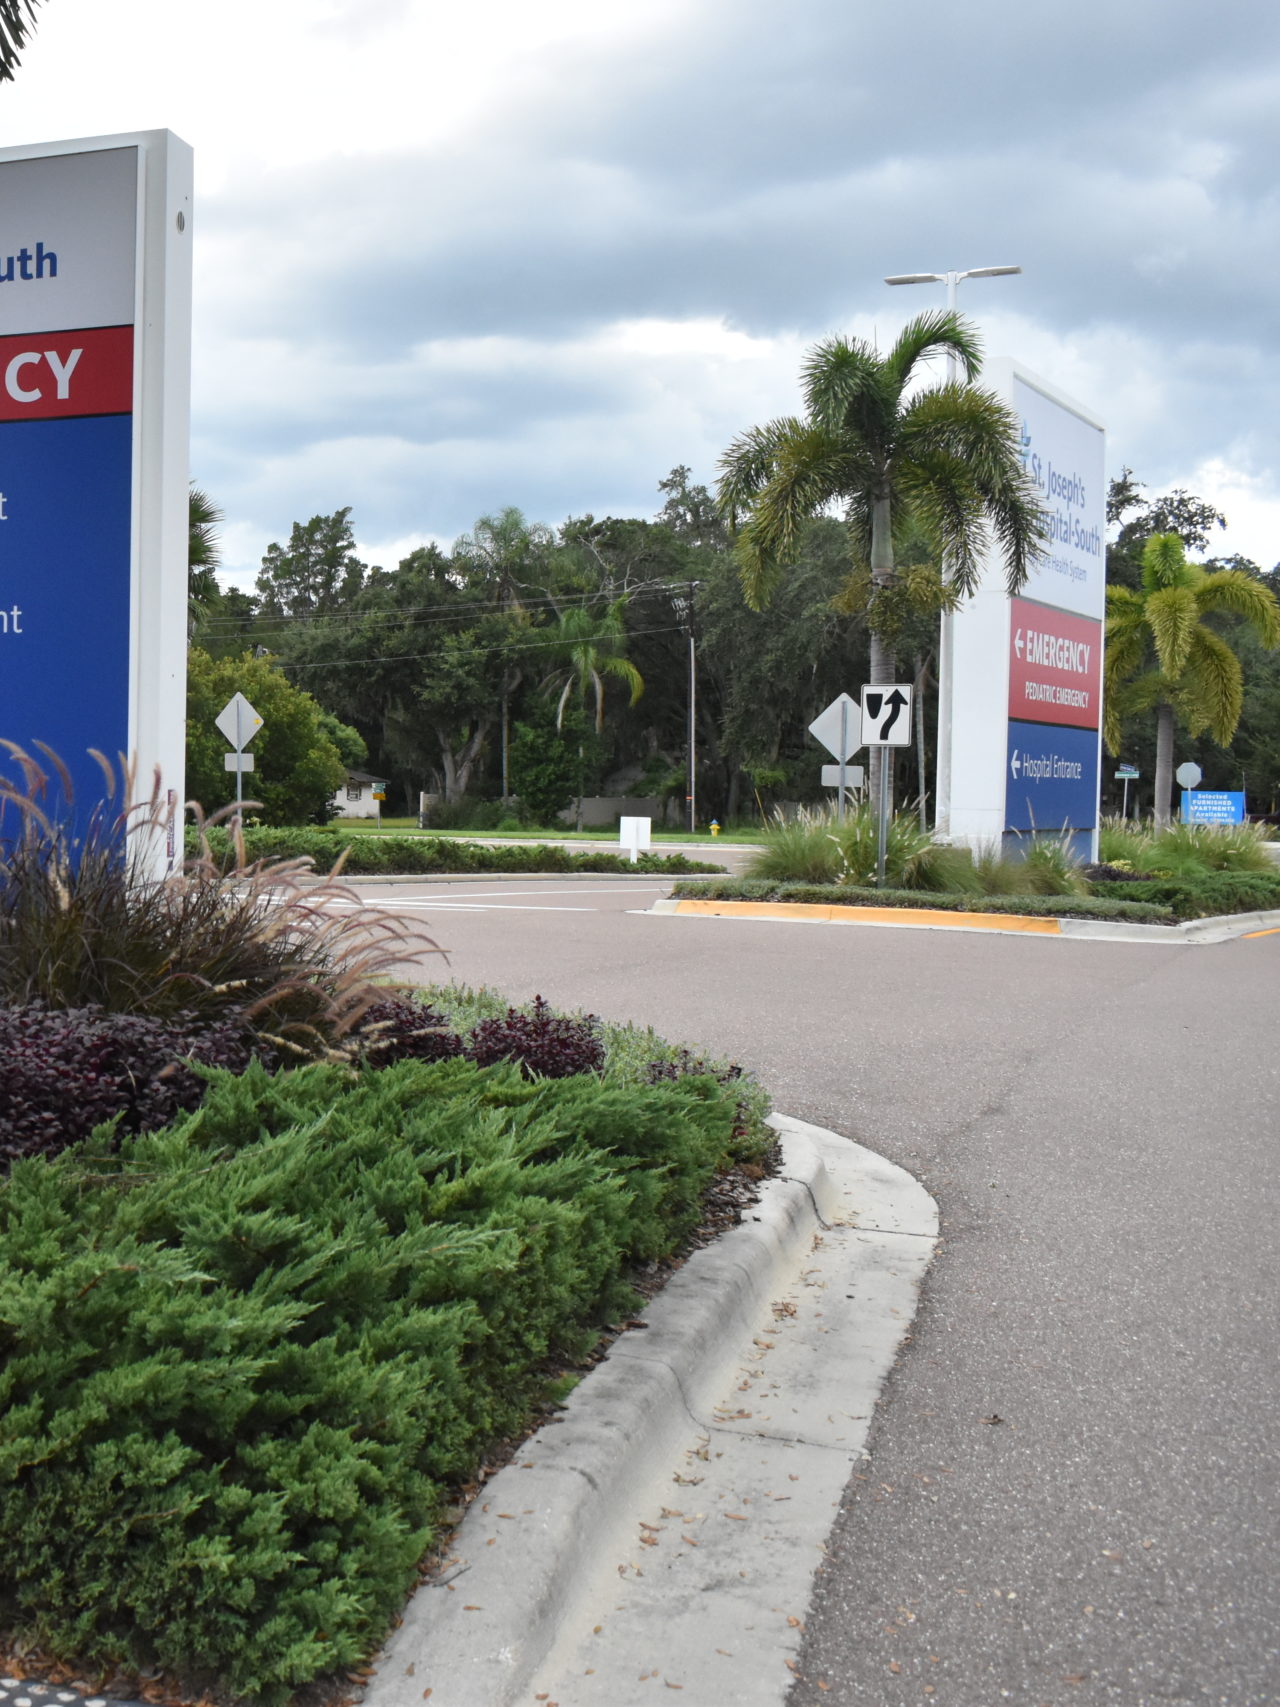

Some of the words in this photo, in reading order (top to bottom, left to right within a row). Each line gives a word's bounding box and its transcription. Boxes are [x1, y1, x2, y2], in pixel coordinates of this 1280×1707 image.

[1026, 629, 1091, 675] EMERGENCY
[1025, 681, 1056, 704] PEDIATRIC
[1056, 687, 1089, 709] EMERGENCY
[1022, 752, 1053, 784] Hospital
[1053, 755, 1083, 780] Entrance
